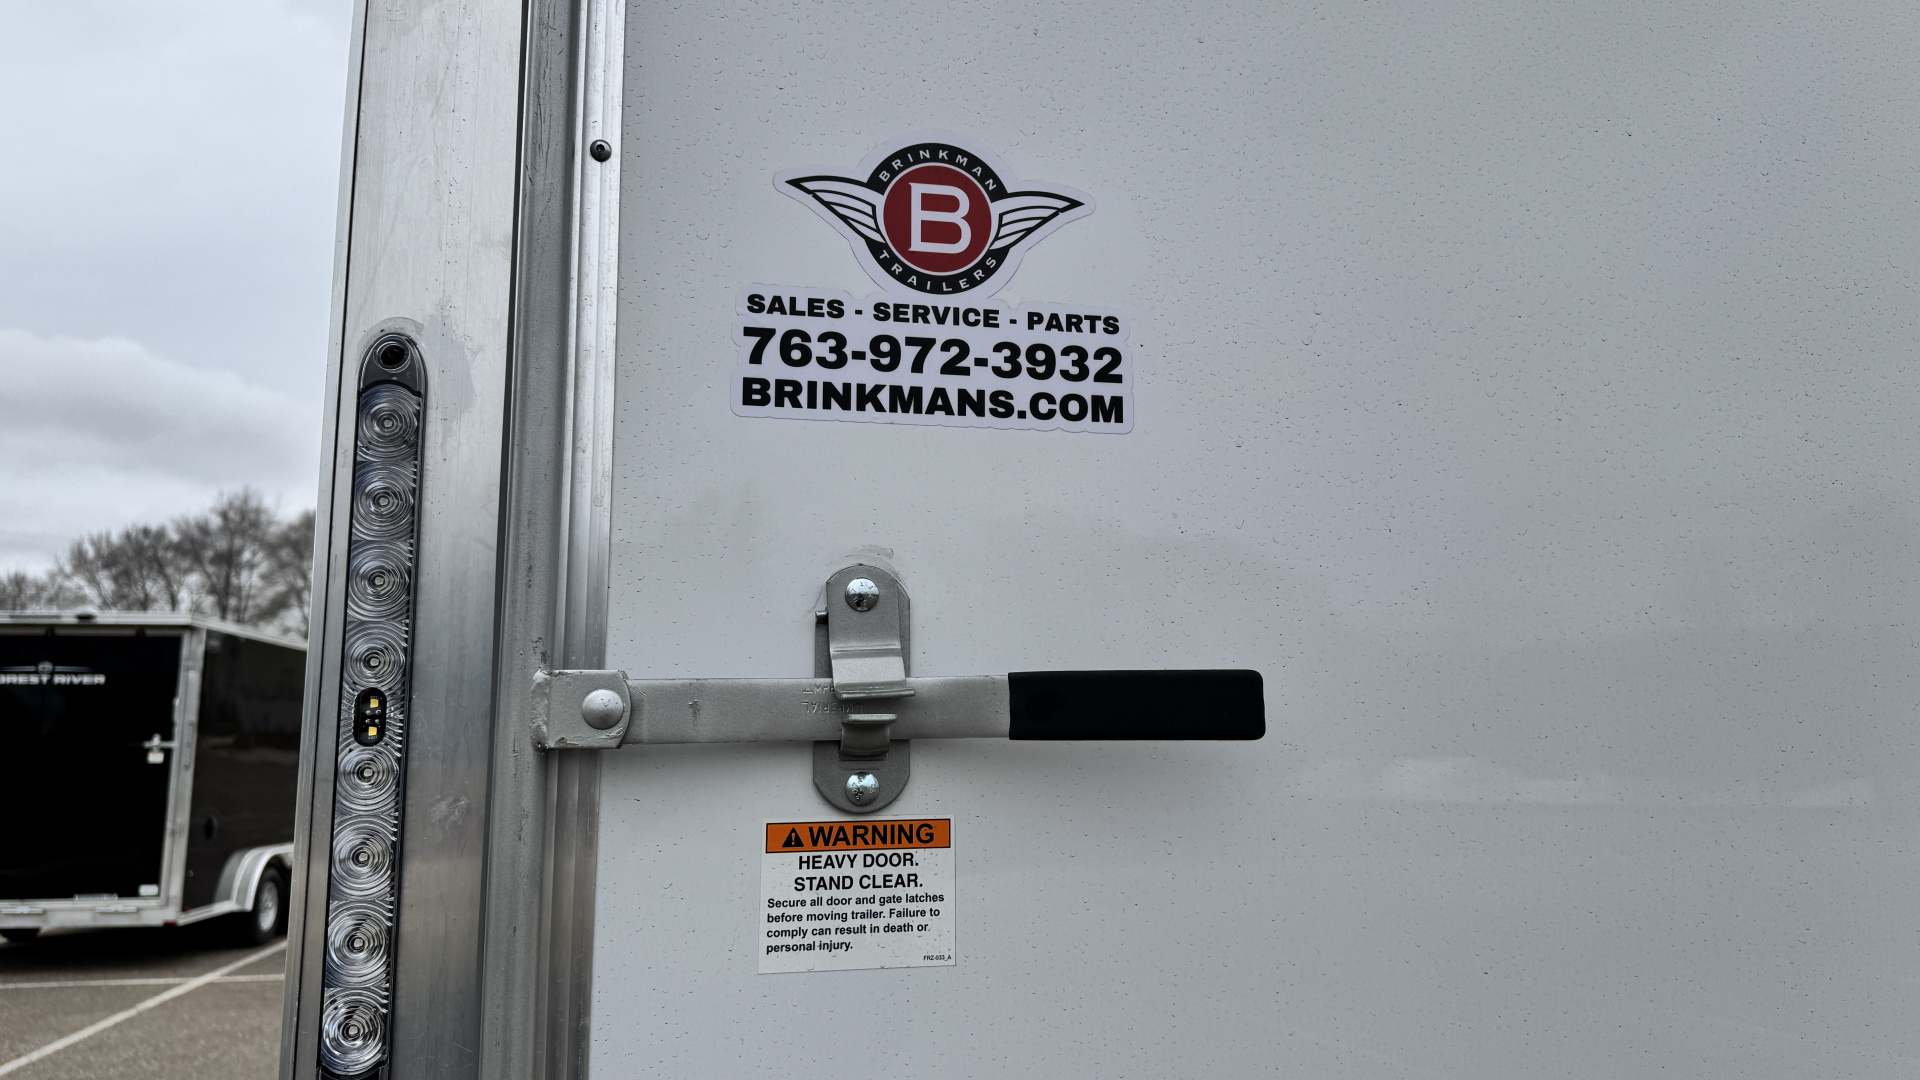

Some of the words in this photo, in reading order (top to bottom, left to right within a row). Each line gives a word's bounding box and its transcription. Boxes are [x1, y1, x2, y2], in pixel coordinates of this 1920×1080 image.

[878, 149, 997, 192] BRINKMAN
[907, 181, 972, 254] B
[878, 249, 998, 292] TRAILERS
[746, 293, 845, 319] SALES
[872, 301, 1000, 329] SERVICE
[1027, 311, 1120, 335] PARTS
[742, 326, 1123, 385] 763-972-3932
[741, 376, 1124, 424] BRINKMANS.COM
[52, 673, 106, 685] RIVER
[808, 823, 935, 847] WARNING
[798, 854, 858, 870] HEAVY
[862, 852, 919, 868] DOOR.
[794, 875, 854, 892] STAND
[858, 873, 923, 889] CLEAR.
[767, 898, 807, 908] Secure
[810, 896, 823, 906] all
[826, 896, 852, 905] door
[855, 894, 876, 905] and
[878, 894, 902, 906] gate
[905, 892, 945, 903] latches
[767, 912, 803, 923] before
[806, 910, 848, 922] moving
[851, 909, 886, 920] trailer.
[889, 908, 926, 918] Failure
[929, 907, 940, 917] to
[766, 926, 808, 939] comply
[811, 927, 831, 936] can
[834, 923, 867, 935] result
[869, 923, 880, 933] in
[883, 922, 914, 933] death
[916, 923, 929, 932] or
[766, 940, 816, 955] personal
[819, 940, 853, 952] injury.
